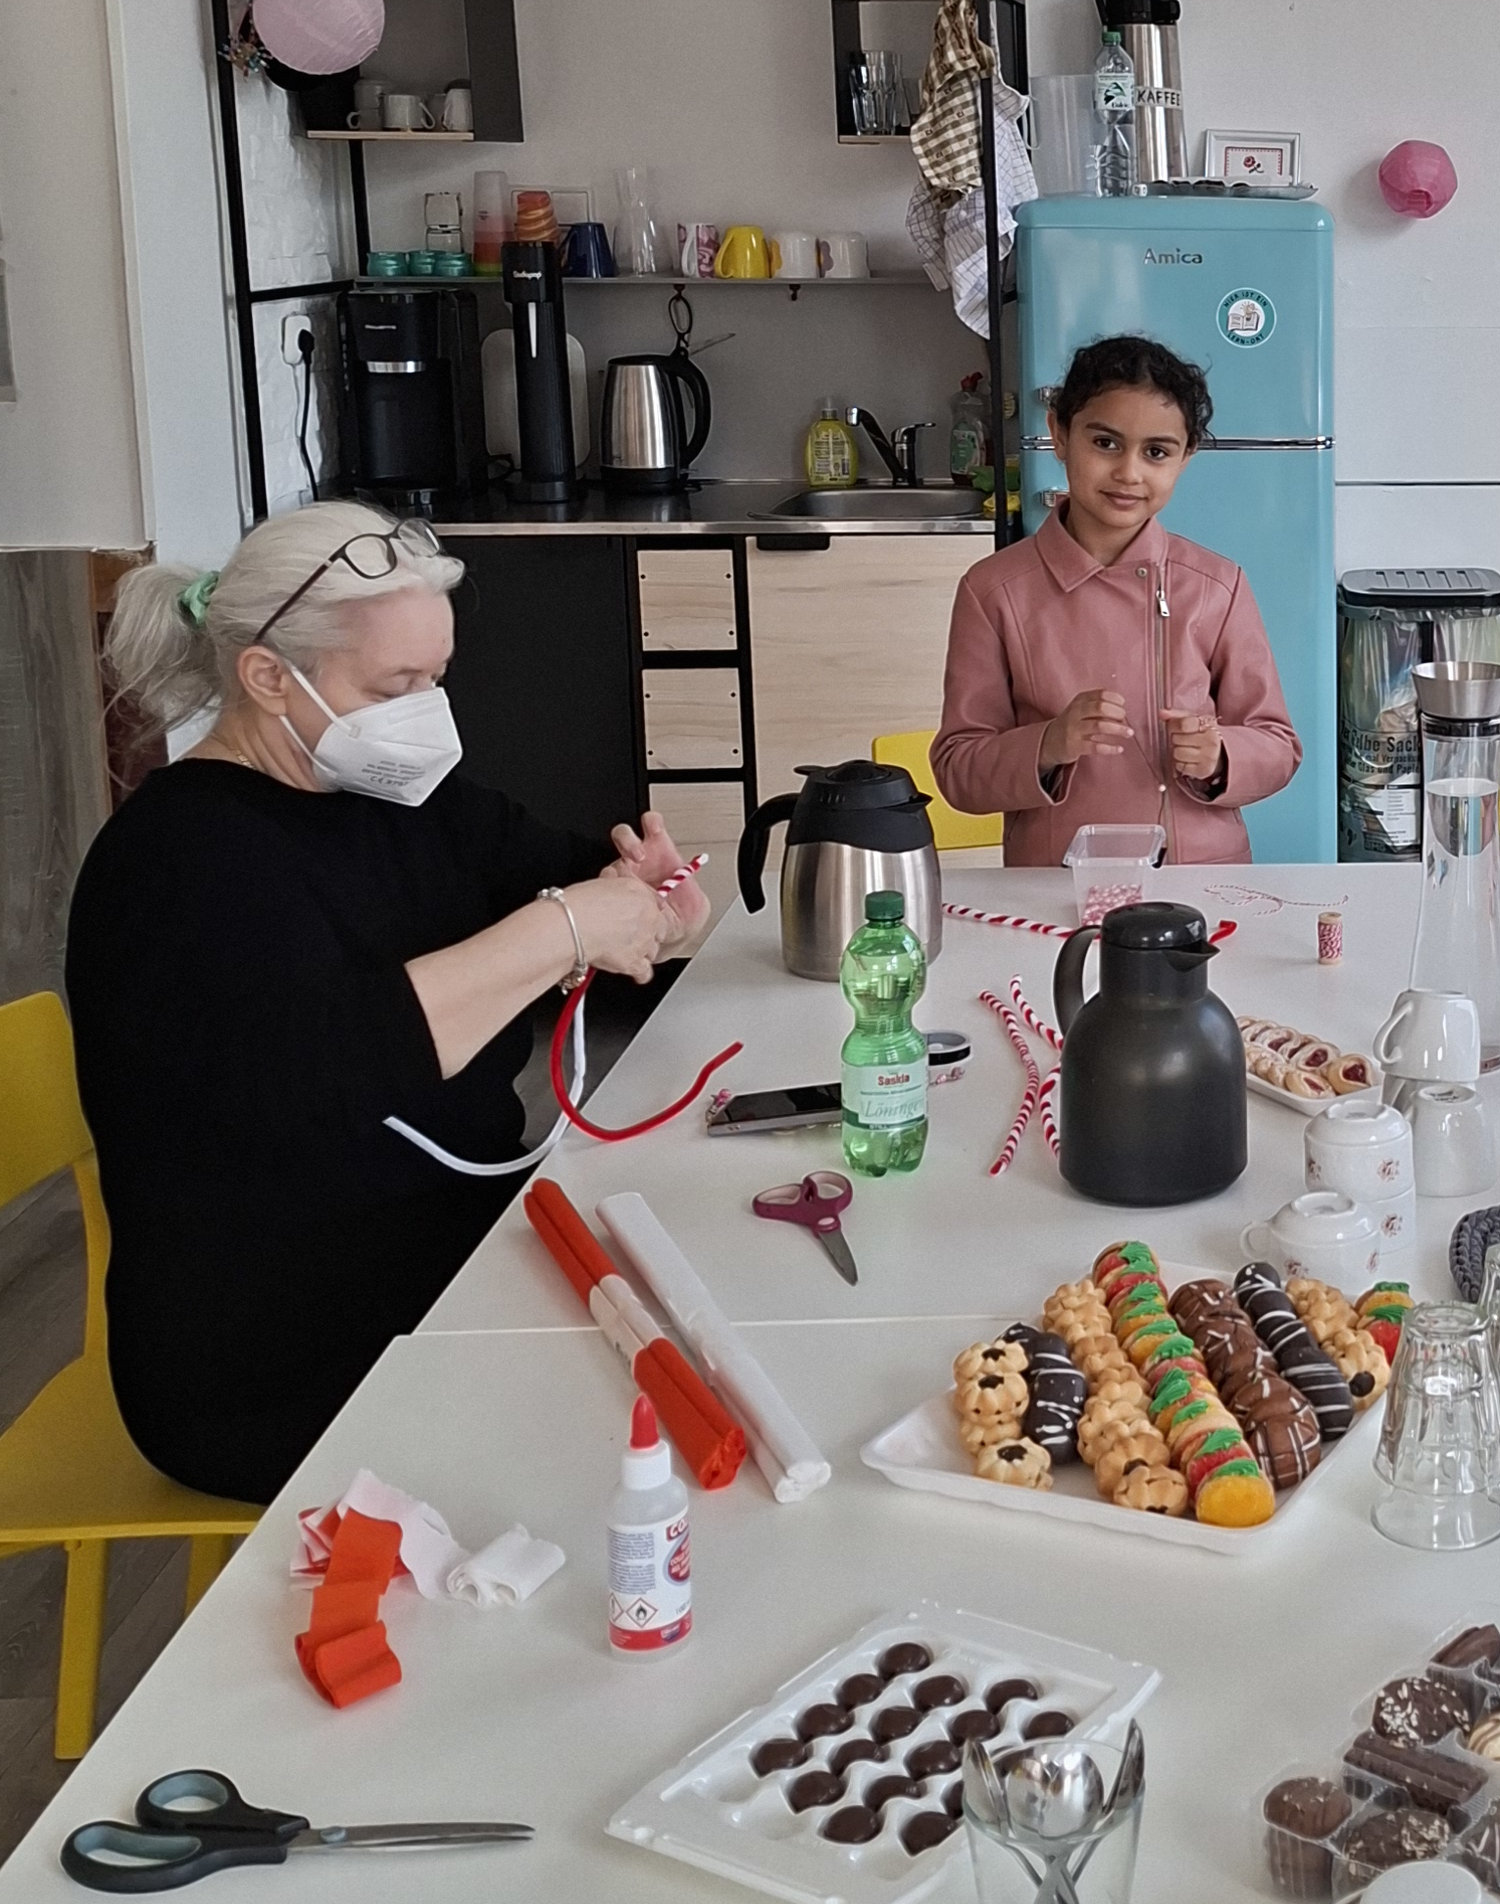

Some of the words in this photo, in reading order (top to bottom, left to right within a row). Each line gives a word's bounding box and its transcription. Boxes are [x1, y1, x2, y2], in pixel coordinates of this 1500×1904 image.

[1137, 89, 1180, 106] KAFFEE
[1143, 247, 1203, 265] Amica
[878, 1074, 910, 1086] Saskia
